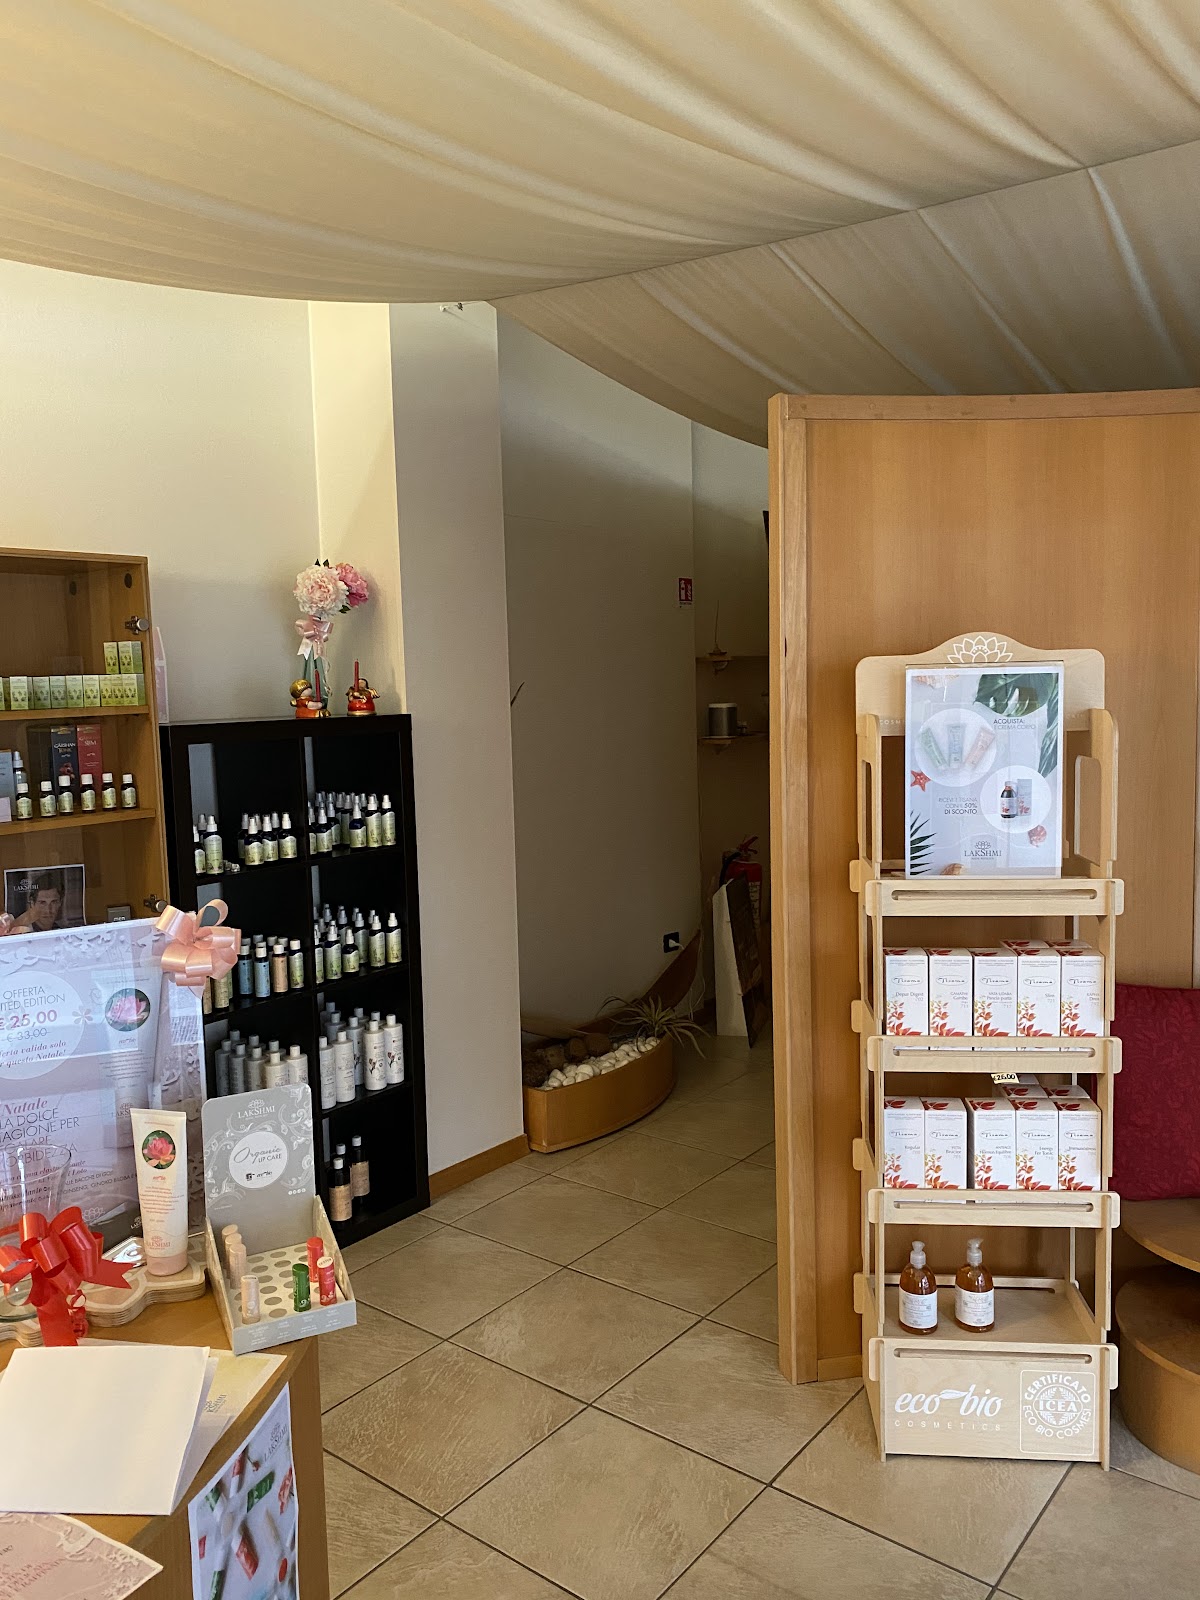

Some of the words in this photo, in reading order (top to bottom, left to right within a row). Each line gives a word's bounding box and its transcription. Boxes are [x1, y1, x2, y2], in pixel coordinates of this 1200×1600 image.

[964, 848, 1002, 857] LAKSHMI
[3, 986, 46, 1000] OFFERTA
[0, 1000, 21, 1012] ITED
[24, 994, 66, 1008] EDITION
[10, 1010, 58, 1028] 25,00
[17, 1028, 48, 1040] 33,00
[0, 1048, 18, 1058] ferta
[21, 1042, 48, 1053] valida
[50, 1040, 66, 1048] solo
[6, 1056, 34, 1068] questo
[36, 1049, 66, 1060] Natale!
[1, 1098, 48, 1116] Natale
[238, 1106, 276, 1118] LAKSHMI
[16, 1108, 59, 1126] DOLCE
[60, 1116, 80, 1130] PER
[234, 1146, 281, 1164] Organic
[266, 1154, 281, 1162] CARE
[1024, 1374, 1090, 1403] CERTIFICATO
[206, 1394, 227, 1412] KSHMI
[1038, 1400, 1078, 1412] ICEA
[894, 1420, 1001, 1432] COSMETICS
[1023, 1405, 1037, 1426] ECO
[1035, 1424, 1054, 1437] BIO
[1056, 1408, 1092, 1439] COSMESI
